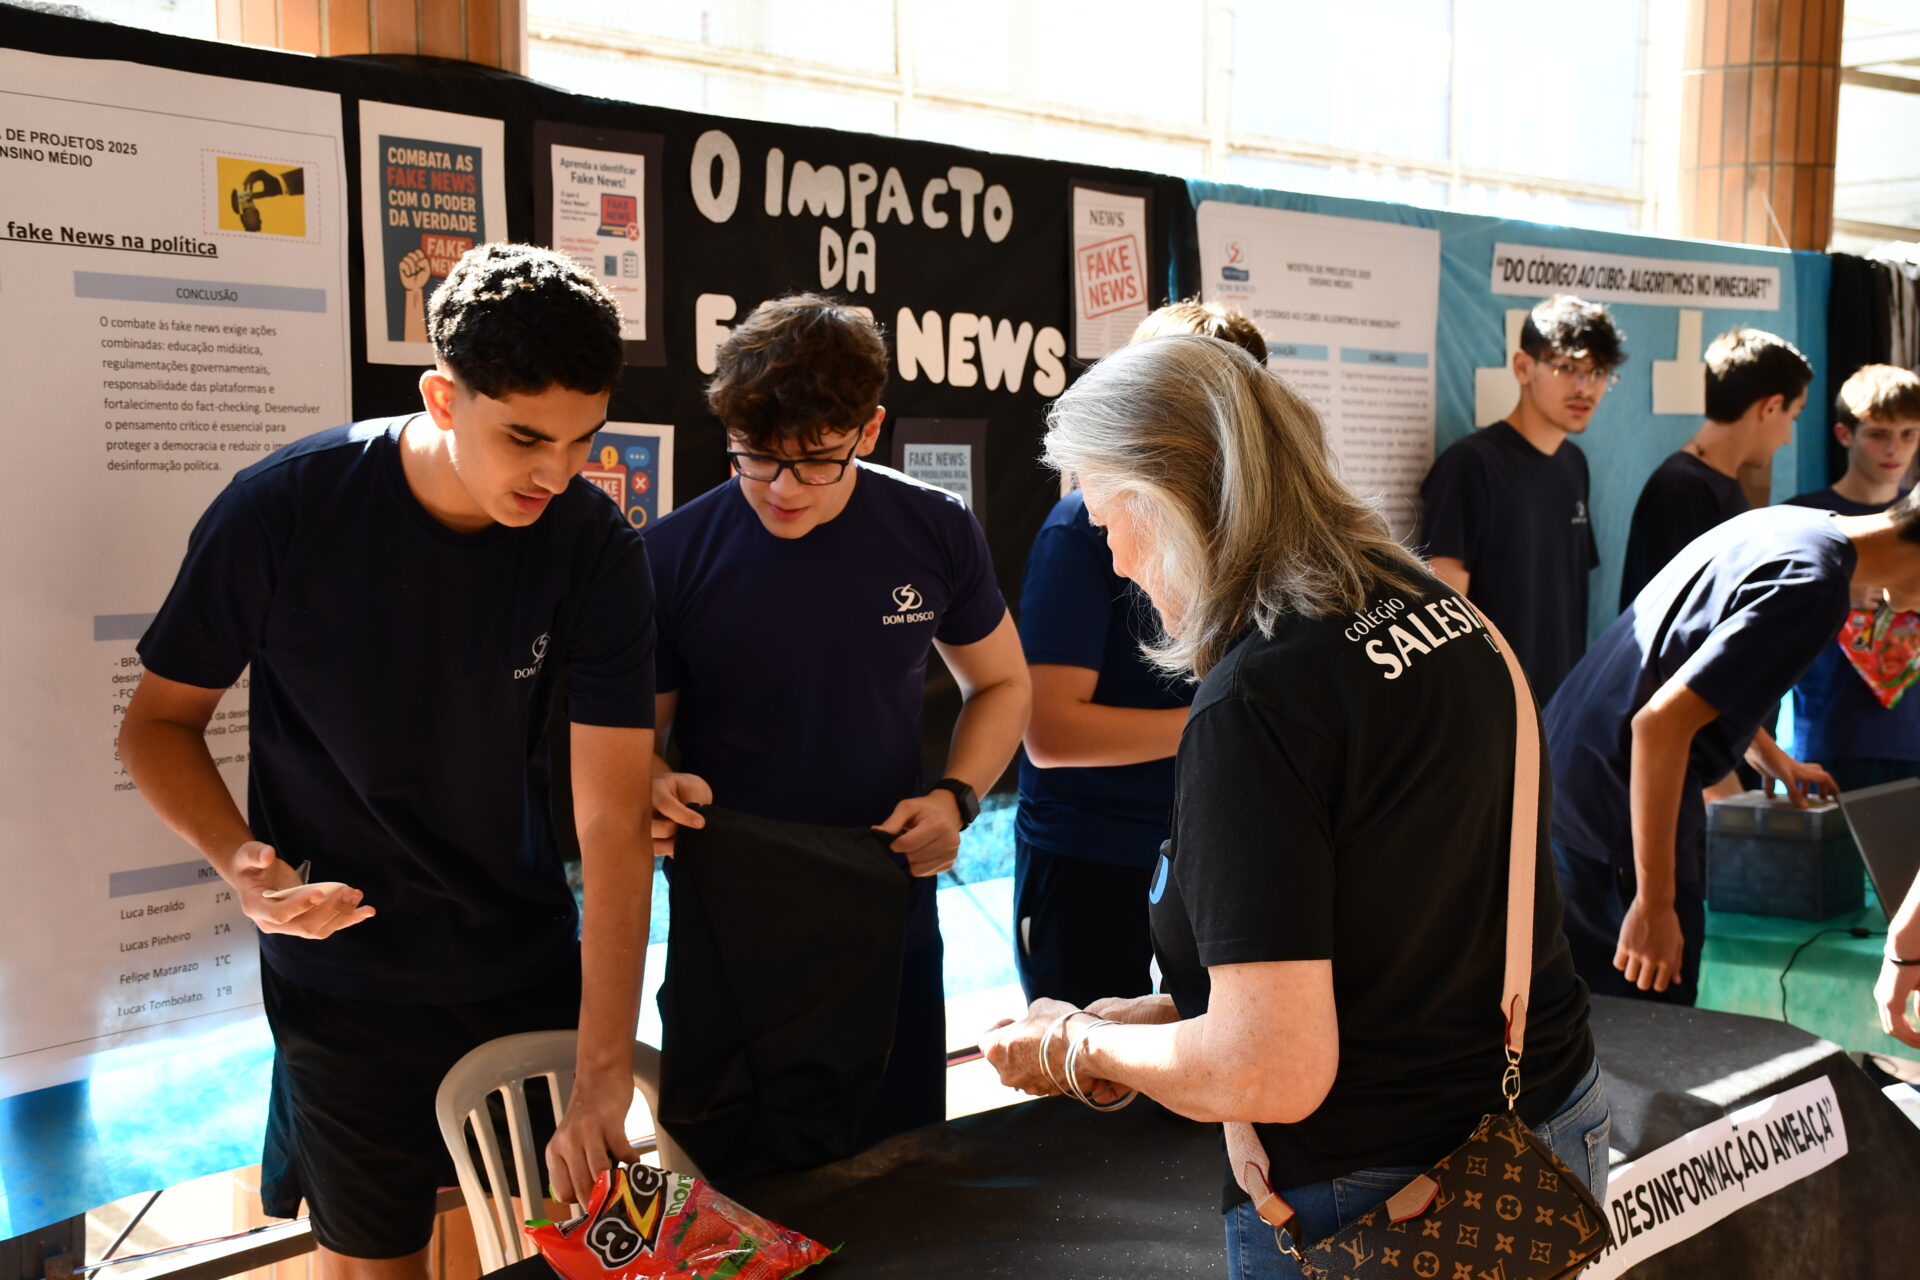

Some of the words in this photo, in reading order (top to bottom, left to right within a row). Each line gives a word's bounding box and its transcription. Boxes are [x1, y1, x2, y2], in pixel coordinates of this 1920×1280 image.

[6, 128, 26, 142] DE
[30, 131, 104, 152] PROJETOS
[108, 141, 138, 156] 2025
[48, 150, 92, 168] MÉDIO
[388, 146, 452, 171] COMBATA
[456, 154, 473, 172] AS
[560, 158, 592, 170] Aprenda
[600, 162, 636, 175] identificar
[386, 166, 427, 190] FAKE
[431, 171, 477, 194] NEWS
[570, 172, 594, 185] Fake
[597, 174, 626, 188] News!
[690, 129, 741, 223] O
[764, 147, 1013, 243] IMPACTO
[388, 190, 418, 208] COM
[421, 193, 431, 208] O
[434, 194, 476, 213] PODER
[389, 208, 410, 228] DA
[412, 211, 478, 233] VERDADE
[1089, 208, 1125, 228] NEWS
[7, 221, 53, 242] fake
[60, 226, 115, 247] News
[121, 235, 144, 249] na
[151, 236, 218, 257] política
[818, 225, 876, 294] DA
[1085, 244, 1132, 281] FAKE
[1528, 254, 1576, 286] CÓDIGO
[1576, 265, 1596, 287] AO
[1628, 269, 1694, 295] ALGORITMOS
[1697, 276, 1711, 296] NO
[176, 286, 238, 302] CONCLUSÃO
[1088, 274, 1138, 310] NEWS
[100, 316, 108, 328] O
[112, 317, 156, 330] combate
[160, 320, 169, 331] às
[171, 320, 192, 333] fake
[194, 324, 220, 334] news
[222, 324, 248, 337] exige
[250, 326, 276, 338] ações
[101, 337, 164, 350] combinadas:
[167, 340, 214, 354] educação
[216, 342, 263, 356] midiática,
[897, 306, 1067, 398] NEWS
[102, 358, 188, 373] regulamentações
[190, 363, 270, 376] governamentais,
[104, 378, 188, 393] responsabilidade
[190, 382, 207, 393] das
[210, 382, 266, 395] plataformas
[268, 386, 275, 394] e
[104, 398, 178, 412] fortalecimento
[180, 400, 194, 411] do
[196, 400, 262, 415] fact-checking.
[265, 403, 320, 414] Desenvolver
[105, 421, 112, 430] o
[115, 420, 177, 434] pensamento
[179, 420, 210, 432] crítico
[212, 420, 218, 432] é
[220, 421, 263, 432] essencial
[265, 423, 286, 435] para
[106, 440, 152, 454] proteger
[154, 442, 160, 451] a
[163, 440, 218, 452] democracia
[220, 443, 226, 451] e
[228, 440, 262, 452] reduzir
[264, 443, 270, 452] o
[108, 460, 182, 473] desinformação
[184, 460, 222, 472] política.
[909, 451, 933, 466] FAKE
[882, 614, 904, 625] DOM
[906, 610, 934, 623] BOSCO
[1365, 596, 1484, 680] SALESI
[120, 908, 144, 920] Luca
[147, 900, 185, 916] Beraldo
[120, 939, 148, 952] Lucas
[151, 930, 191, 946] Pinheiro
[120, 970, 150, 985] Felipe
[153, 962, 199, 979] Matarazo
[118, 1003, 146, 1016] Lucas
[1612, 1125, 1768, 1252] DESINFORMAÇÃO
